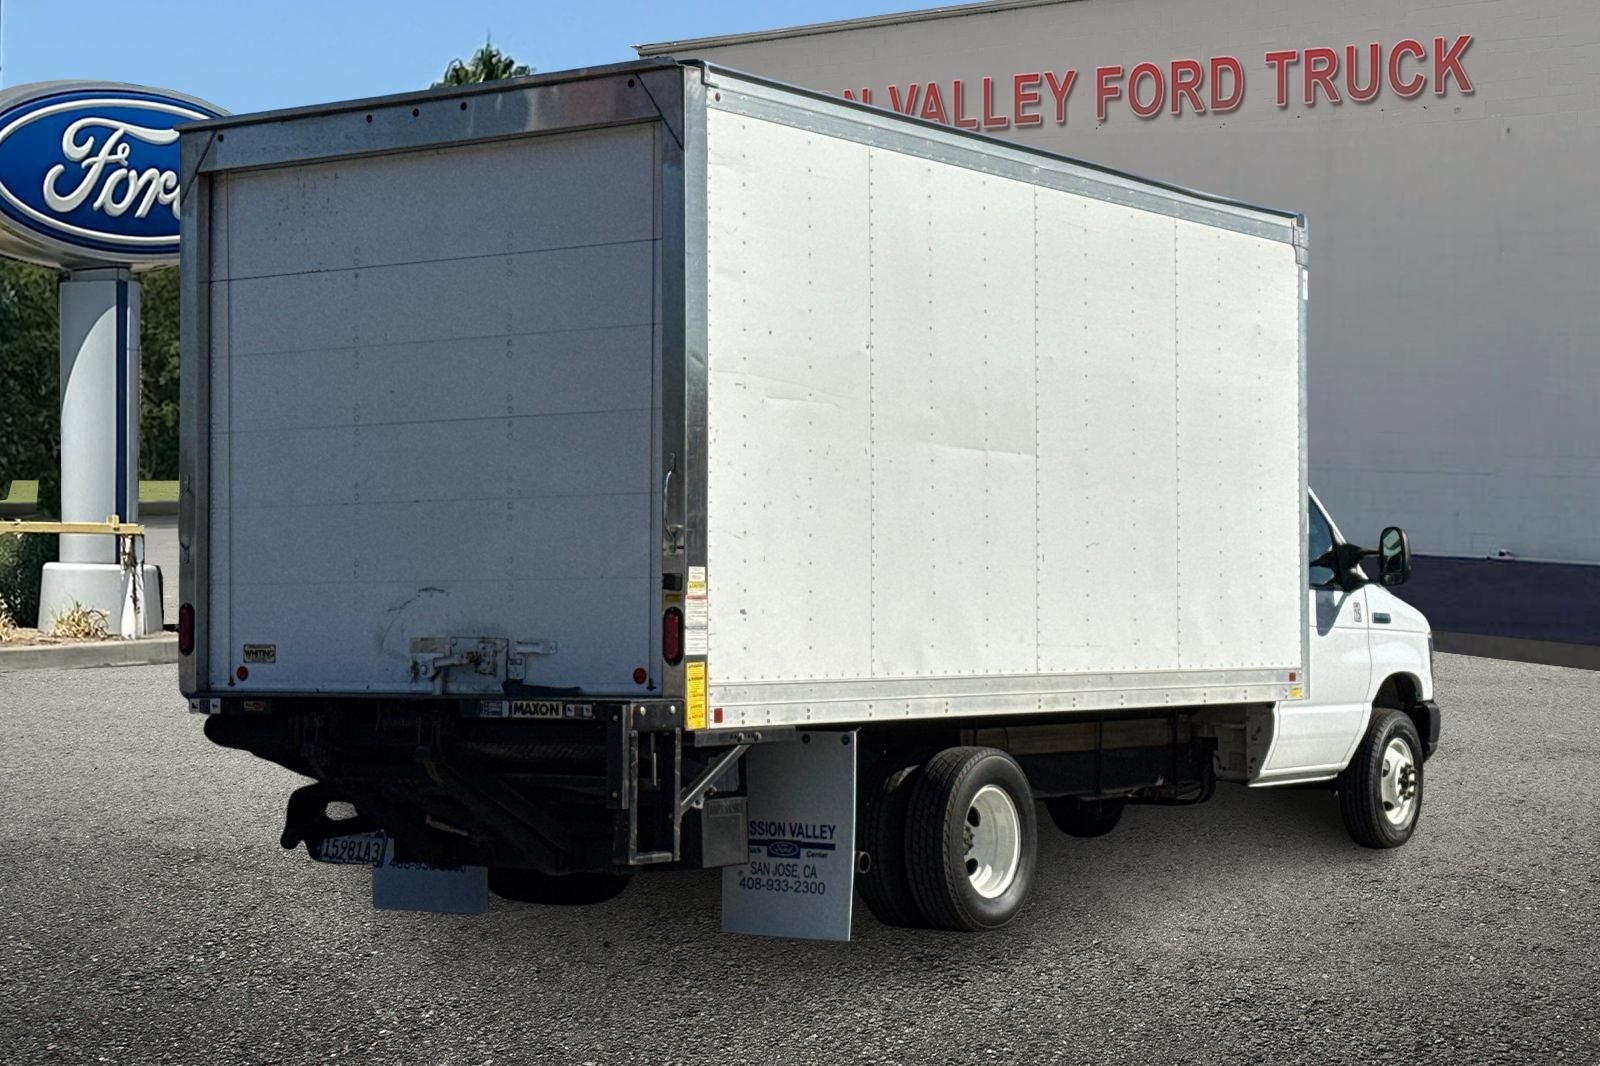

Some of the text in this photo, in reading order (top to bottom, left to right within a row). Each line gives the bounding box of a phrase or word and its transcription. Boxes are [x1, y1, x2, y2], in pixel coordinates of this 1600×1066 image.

[888, 34, 1475, 129] VALLEY FORD TRUCK
[43, 117, 180, 218] For
[513, 702, 560, 716] MAXON
[789, 823, 836, 840] VALLEY
[750, 861, 818, 879] SAN JOSE, CA
[739, 877, 826, 895] 408-933-2300
